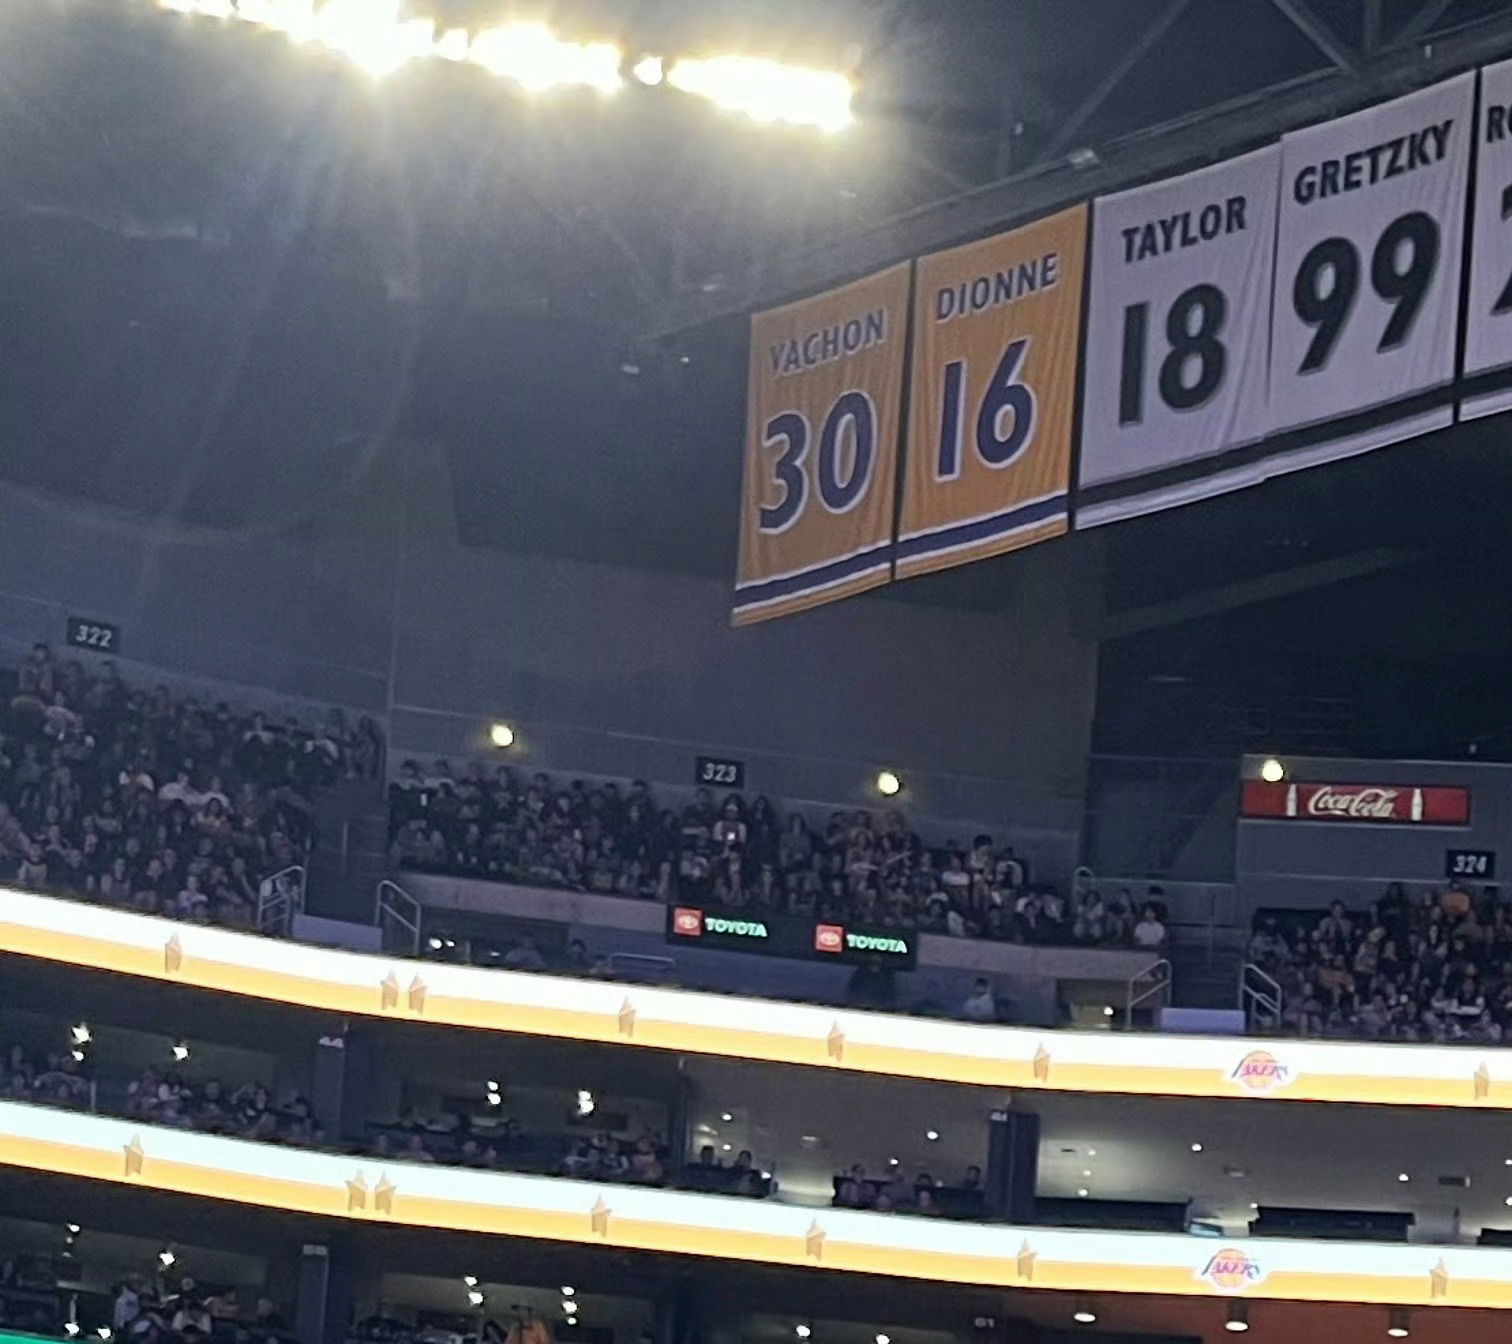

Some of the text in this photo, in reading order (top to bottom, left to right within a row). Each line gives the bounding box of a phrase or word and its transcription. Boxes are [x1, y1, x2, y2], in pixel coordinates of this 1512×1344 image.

[1293, 119, 1454, 206] GRETZKY
[1121, 195, 1249, 263] TAYLOR
[935, 252, 1058, 322] DIONNE
[1292, 210, 1441, 376] 99
[1118, 283, 1231, 429] 18
[936, 336, 1037, 483] 16
[758, 389, 877, 535] 30
[75, 622, 113, 648] 322
[703, 760, 738, 785] 323
[1453, 853, 1488, 875] 324
[705, 917, 768, 938] TOYOTA
[847, 934, 908, 954] TOYOTA
